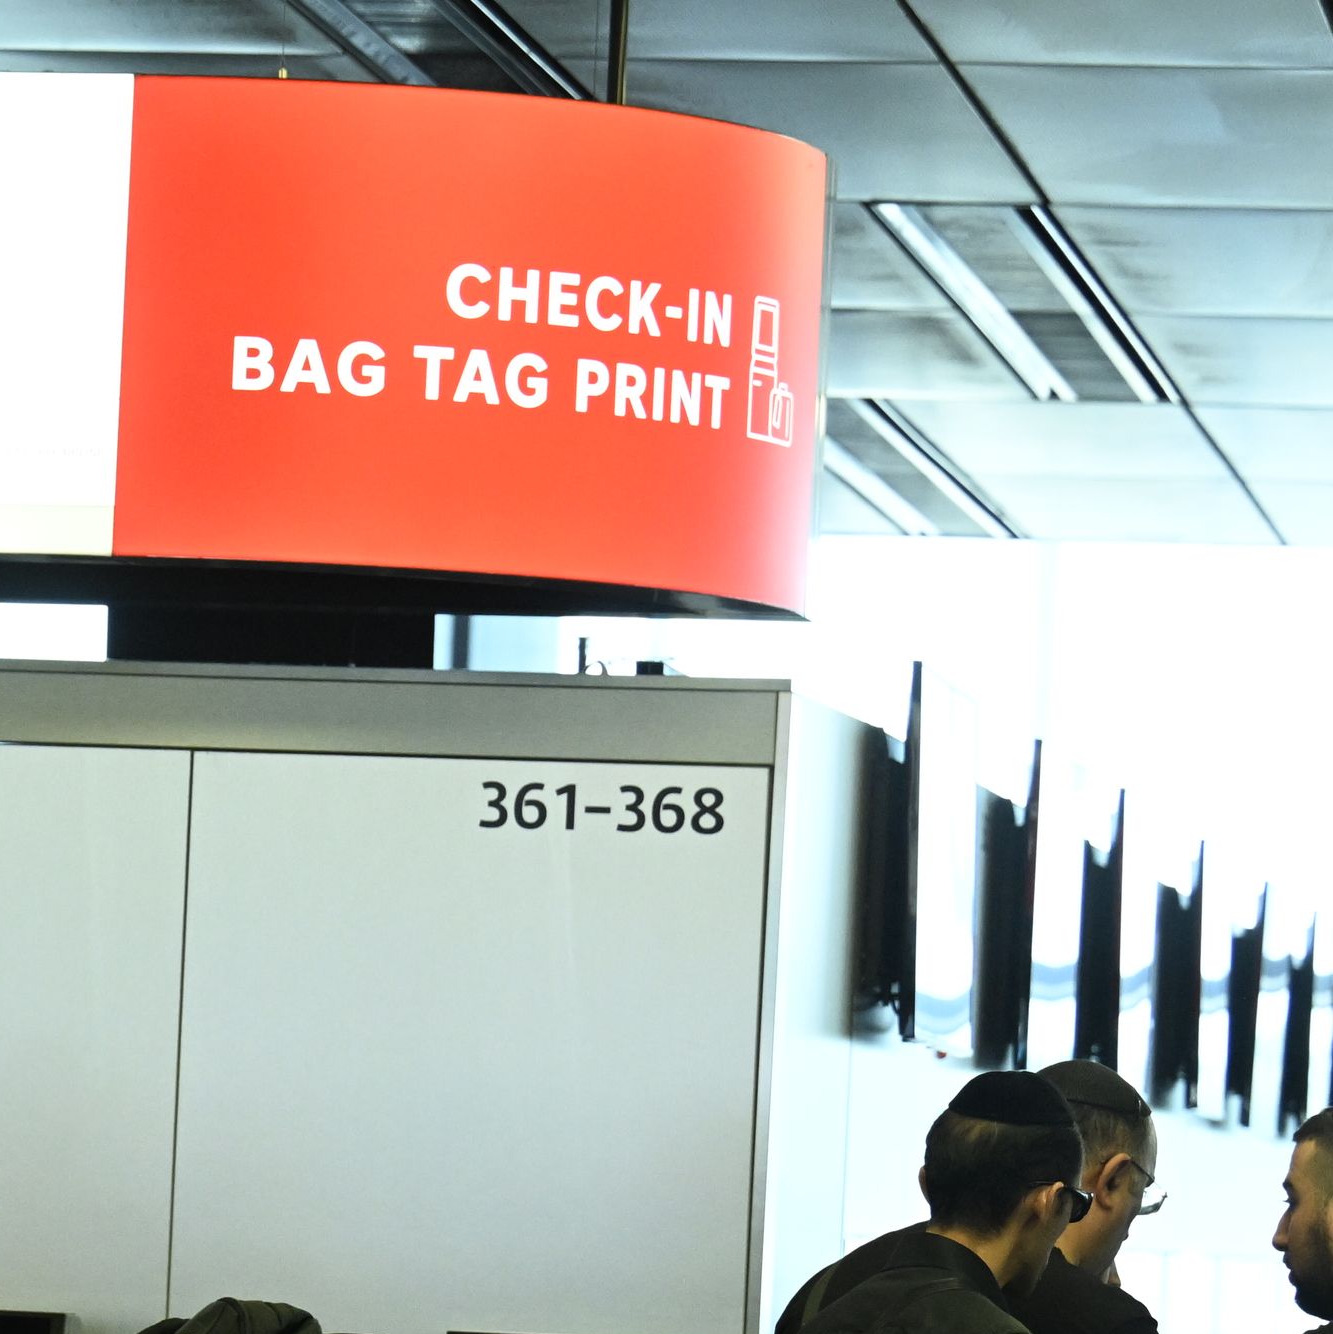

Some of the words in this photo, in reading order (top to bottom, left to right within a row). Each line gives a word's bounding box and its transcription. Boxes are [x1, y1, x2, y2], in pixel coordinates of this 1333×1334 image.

[446, 263, 732, 347] CHECK-IN
[232, 336, 385, 396] BAG
[414, 345, 548, 408] TAG
[575, 359, 730, 429] PRINT
[479, 781, 725, 835] 361-368
